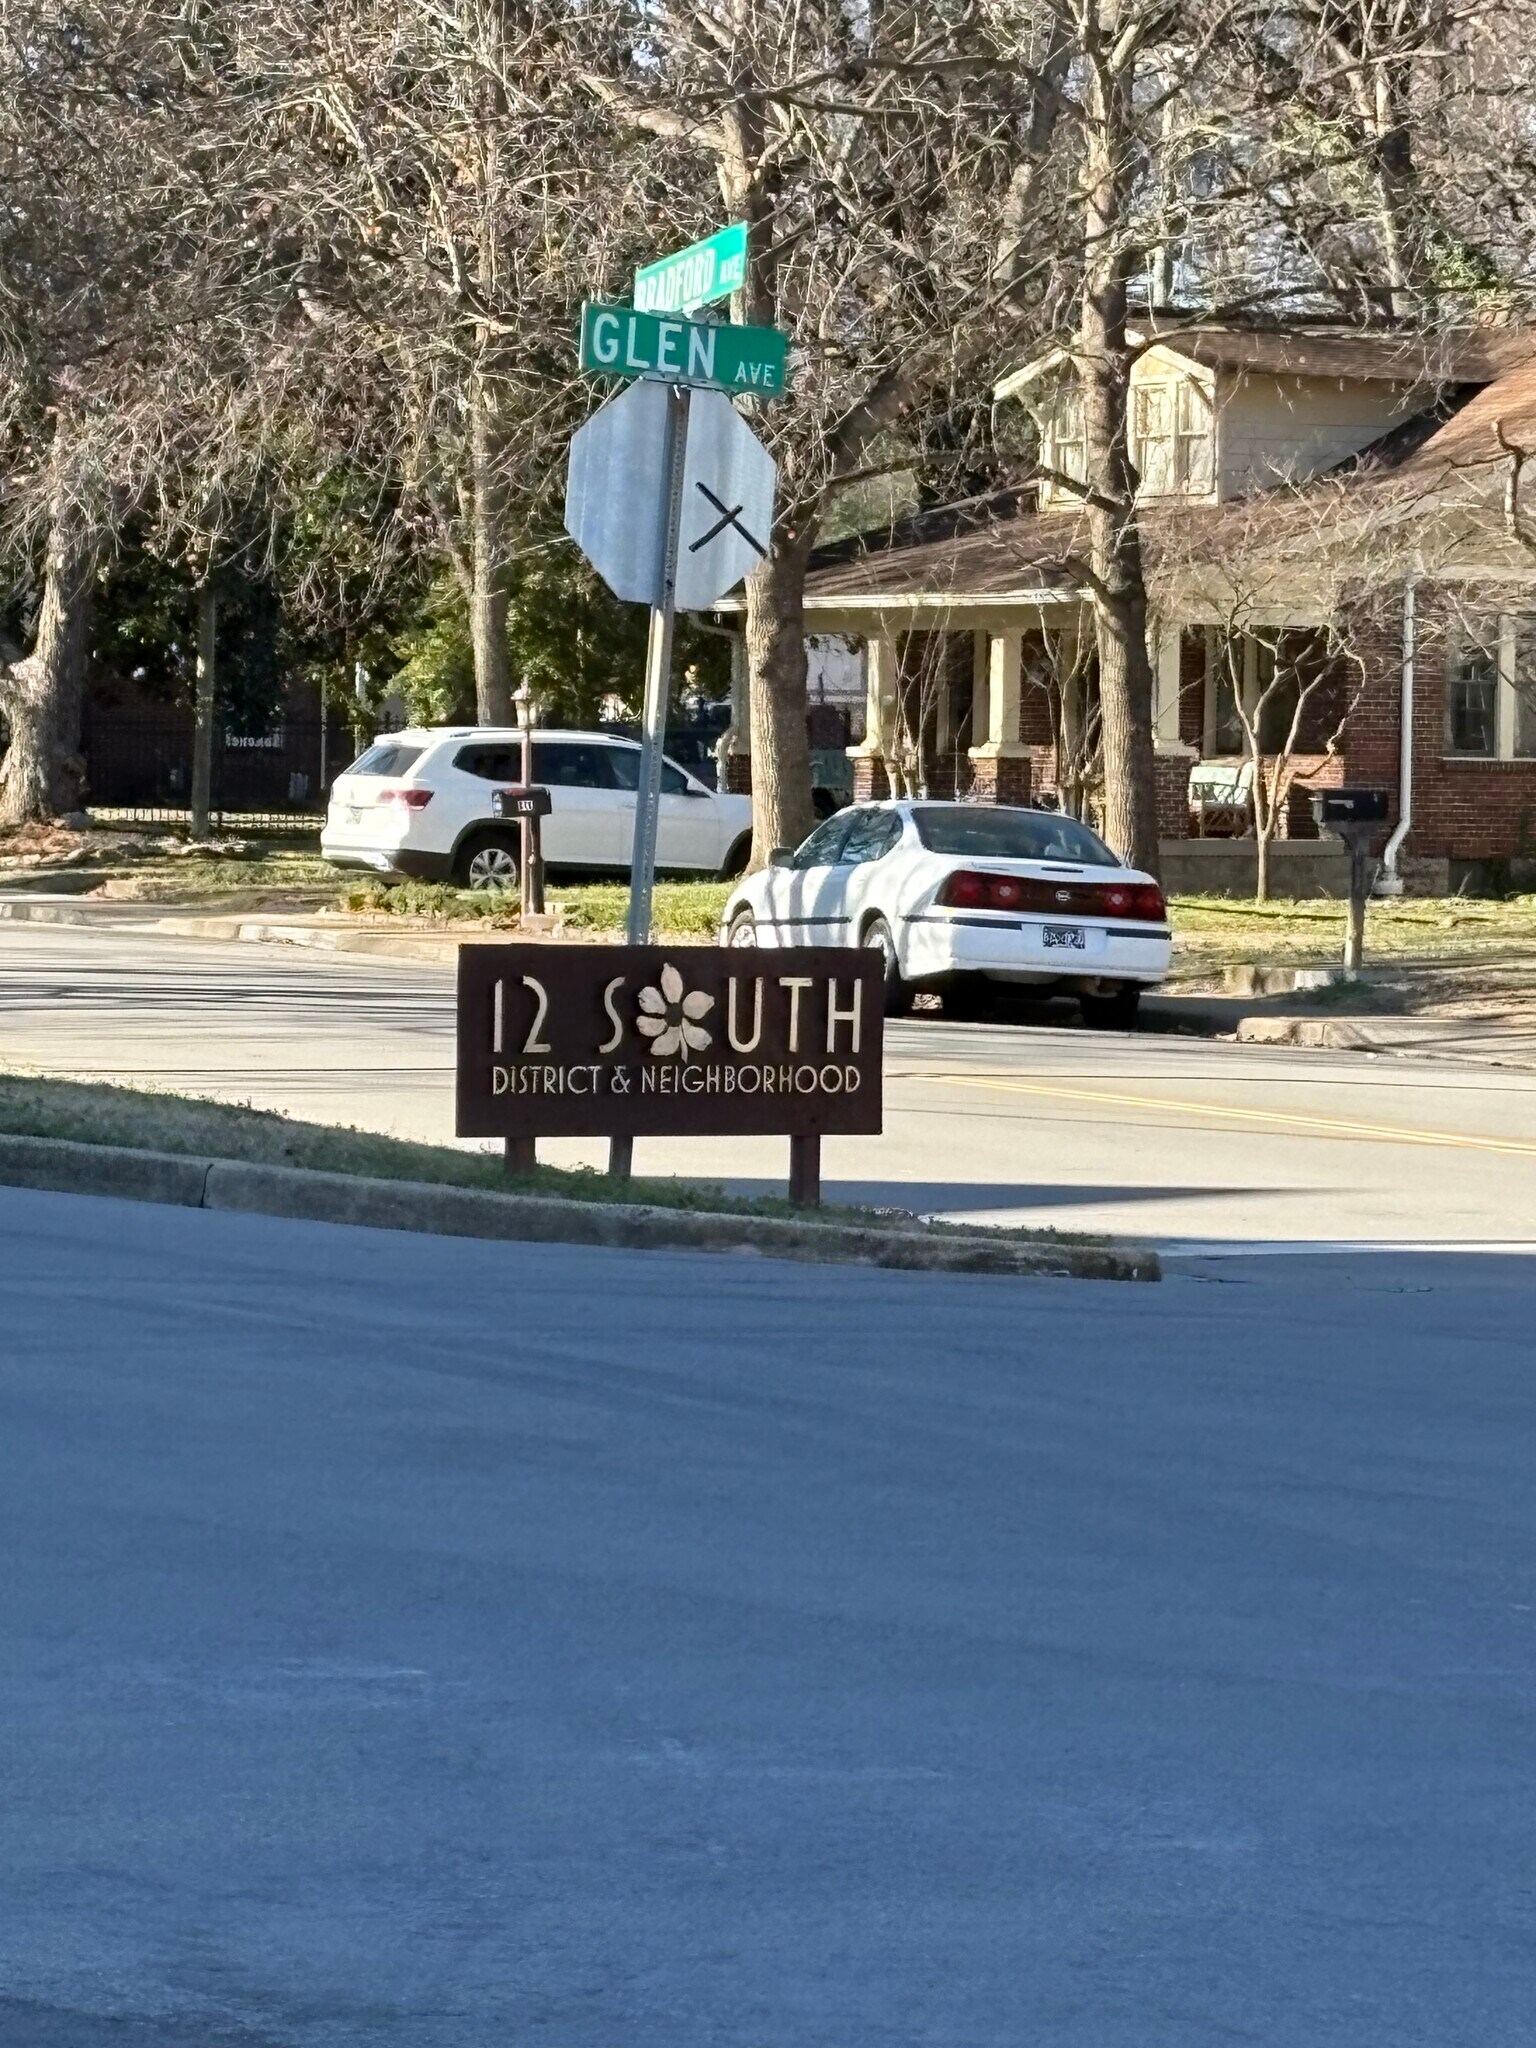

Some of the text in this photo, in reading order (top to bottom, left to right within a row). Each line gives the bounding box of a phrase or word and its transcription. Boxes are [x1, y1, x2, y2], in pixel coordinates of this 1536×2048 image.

[593, 313, 775, 388] GLEN AVE
[494, 976, 551, 1054] 12
[493, 1064, 861, 1095] DISTRICT & NEIGHBORHOOD
